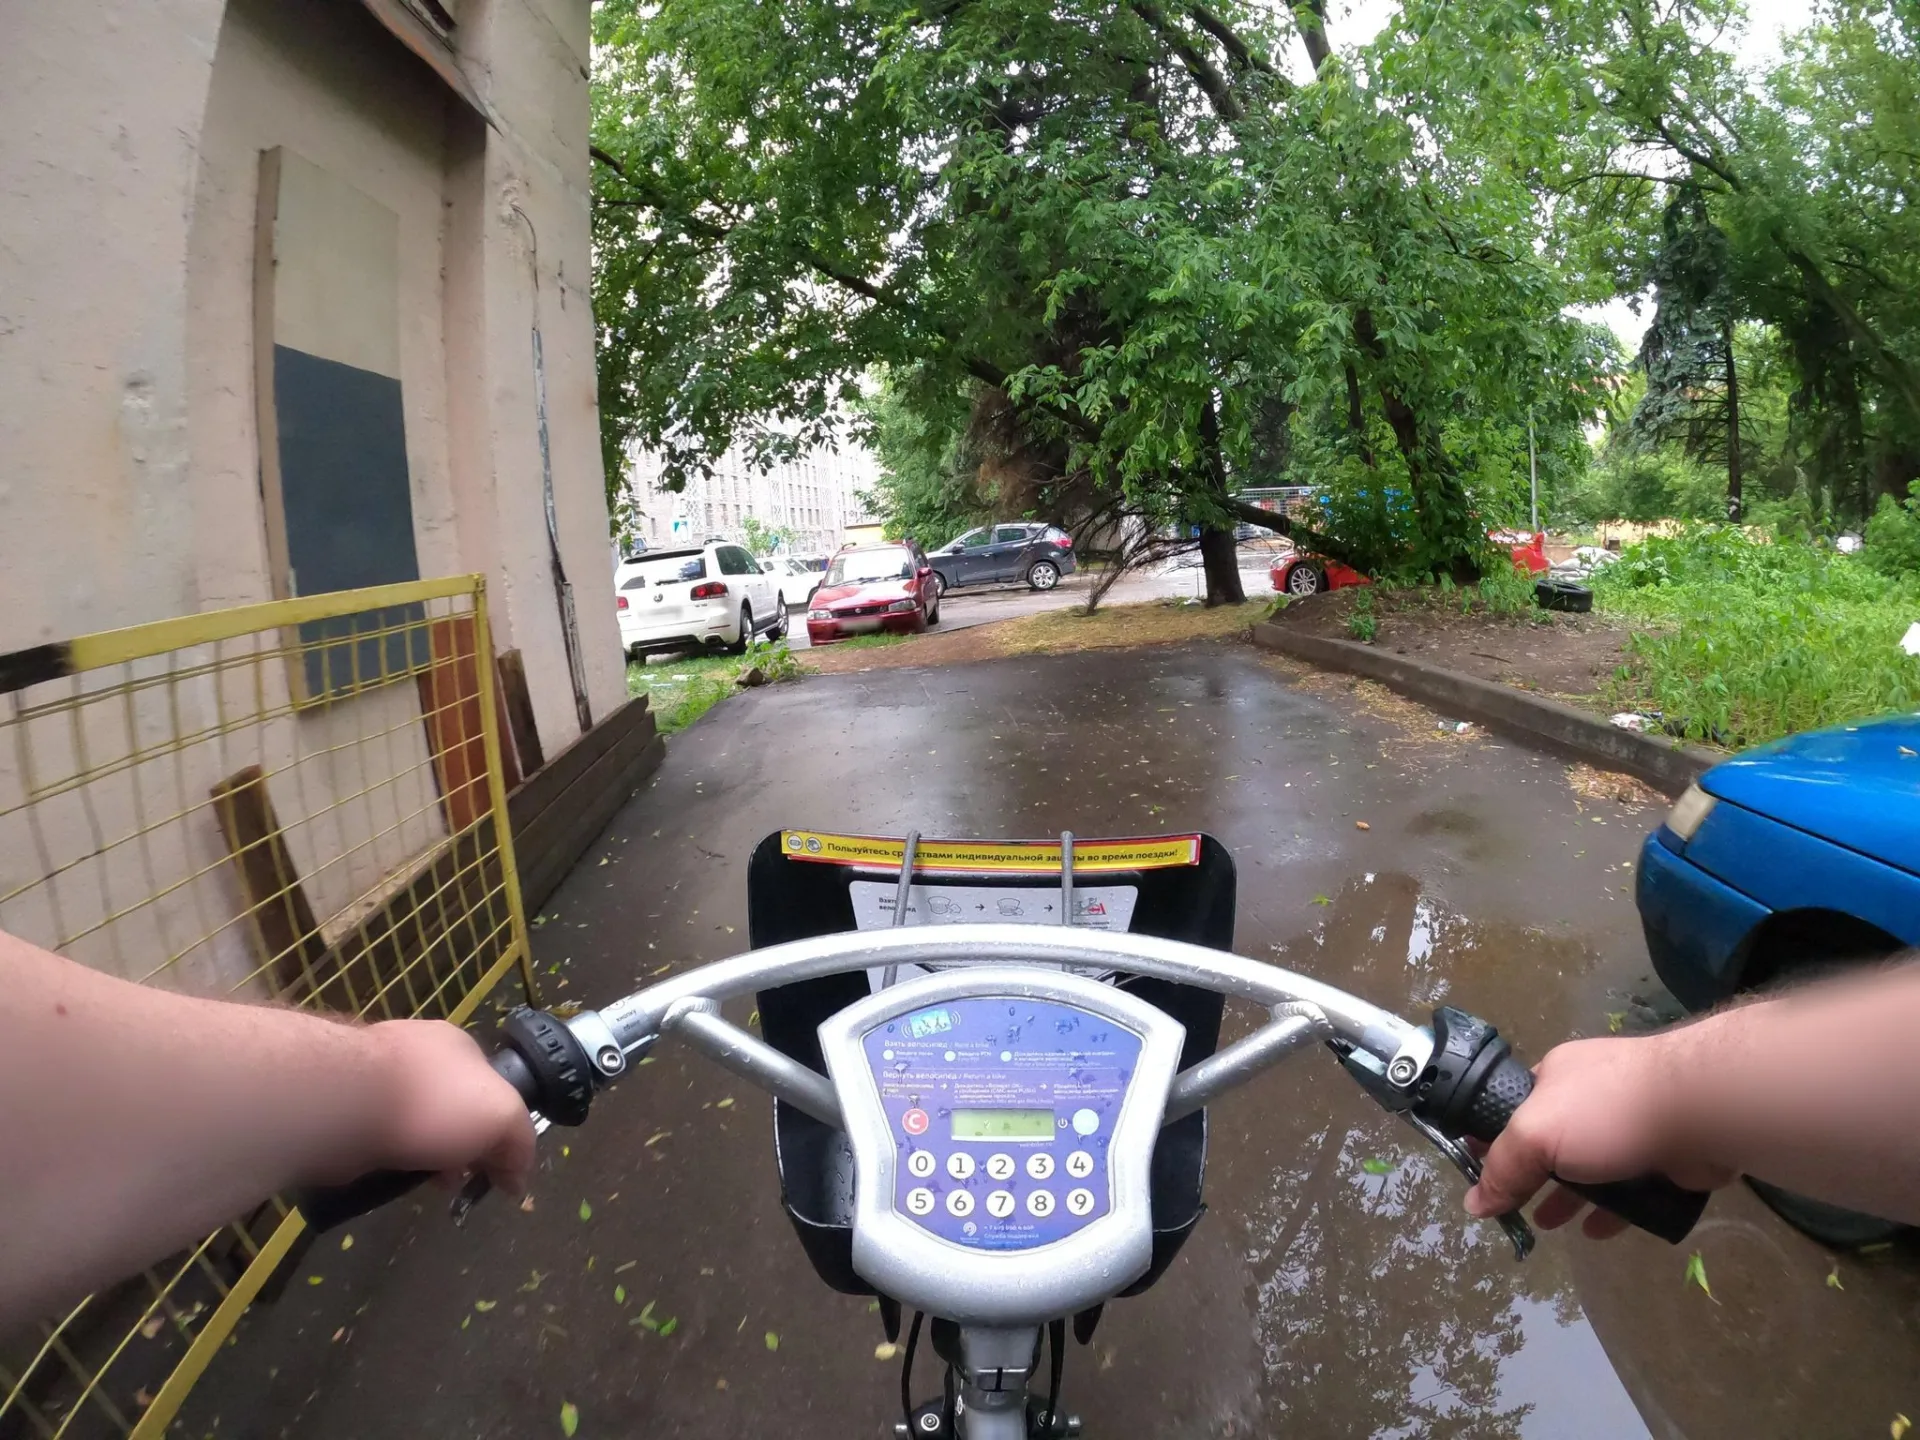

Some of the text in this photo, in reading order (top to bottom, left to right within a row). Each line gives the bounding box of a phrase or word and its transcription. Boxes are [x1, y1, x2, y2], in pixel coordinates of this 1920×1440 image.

[828, 843, 890, 855] Пользуйтесь
[892, 850, 953, 859] срствами
[956, 853, 1043, 862] индивидуальной
[1102, 853, 1133, 862] время
[1136, 849, 1178, 859] поездки!
[908, 1114, 921, 1129] C
[915, 1155, 928, 1171] 0
[956, 1158, 966, 1173] 1
[995, 1159, 1007, 1175] 2
[1035, 1158, 1047, 1174] 3
[1073, 1156, 1086, 1172] 4
[915, 1193, 927, 1209] 5
[954, 1195, 967, 1211] 6
[995, 1196, 1007, 1212] 7
[1034, 1195, 1047, 1211] 8
[1074, 1194, 1087, 1210] 9
